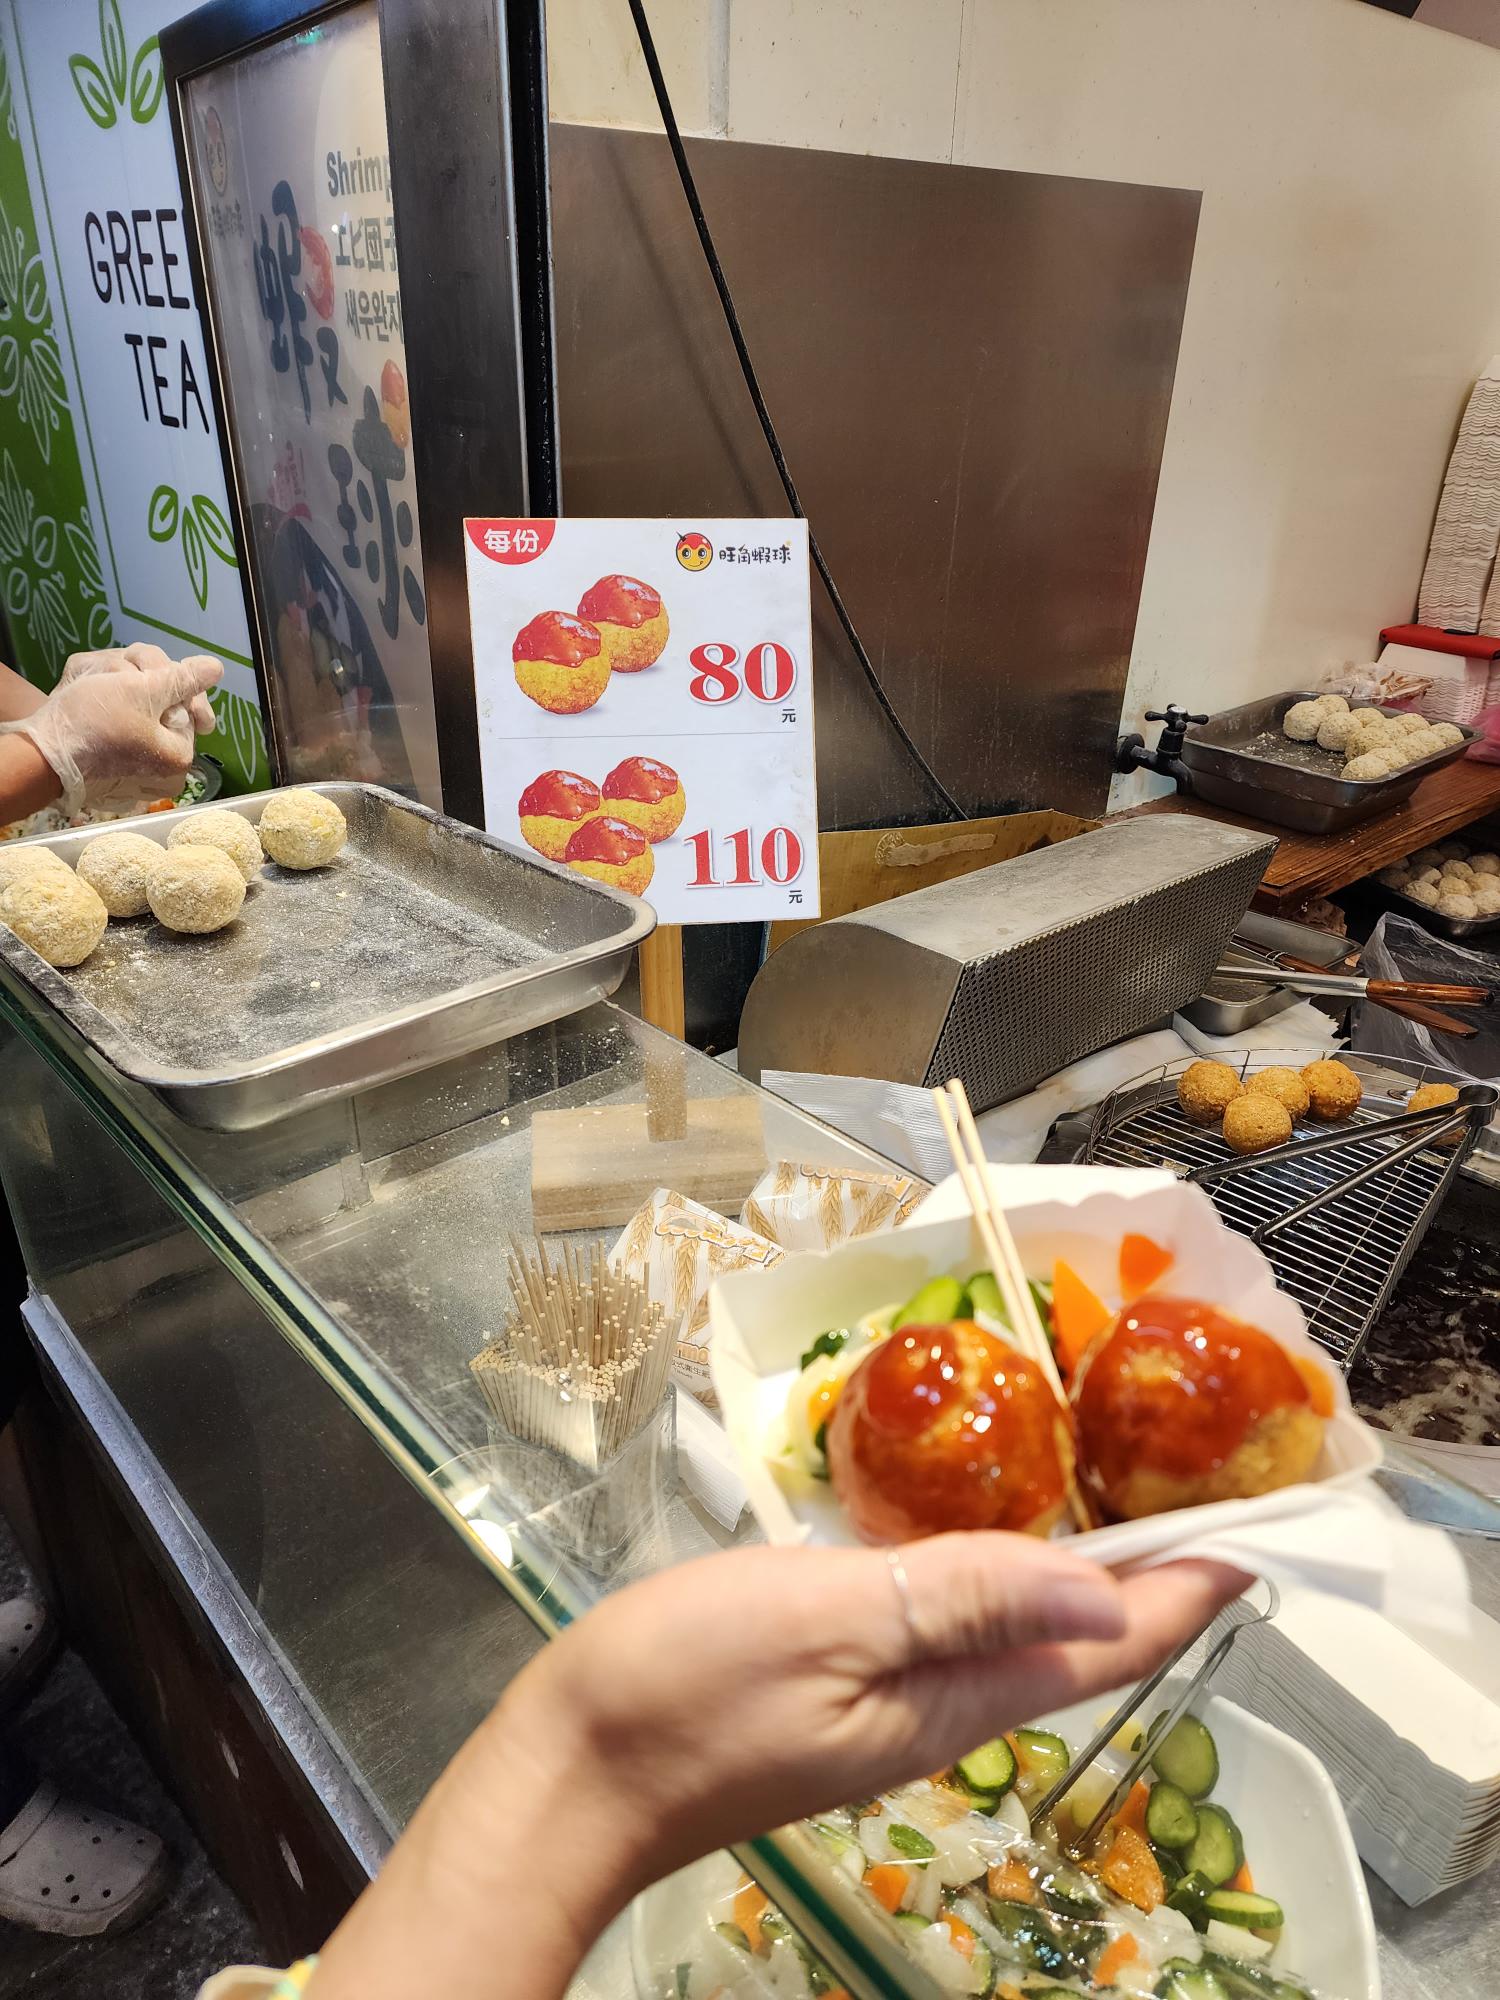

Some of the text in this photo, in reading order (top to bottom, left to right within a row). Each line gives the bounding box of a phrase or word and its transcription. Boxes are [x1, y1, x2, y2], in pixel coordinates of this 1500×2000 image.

[84, 208, 197, 310] GREE
[124, 333, 210, 435] TEA
[483, 528, 540, 554] 每份
[718, 543, 792, 565] 旺角蝦球
[688, 641, 797, 724] 80 元
[683, 826, 804, 905] 110 元
